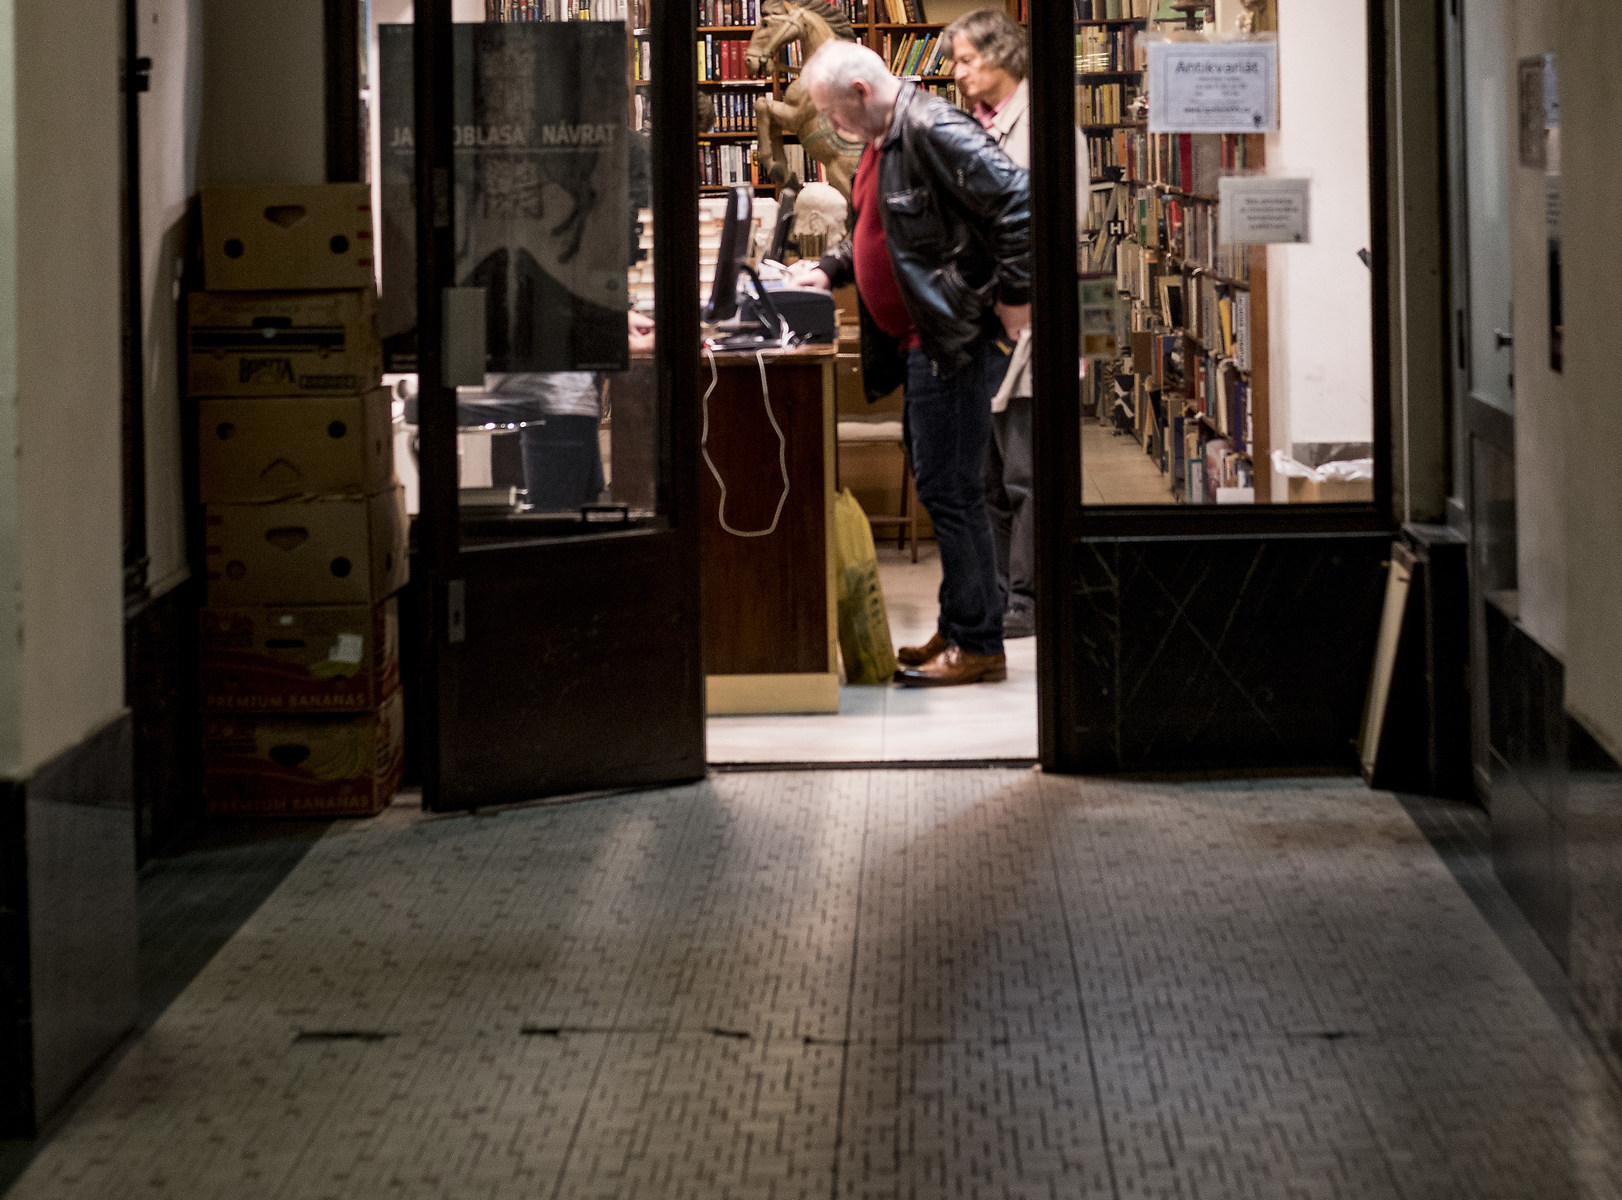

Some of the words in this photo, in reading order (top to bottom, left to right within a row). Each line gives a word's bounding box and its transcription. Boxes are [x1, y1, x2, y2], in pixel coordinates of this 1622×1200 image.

[541, 119, 616, 144] NÁVRAT
[1110, 222, 1122, 234] H
[207, 695, 283, 707] PREMIUM
[288, 693, 365, 706] BANANAS
